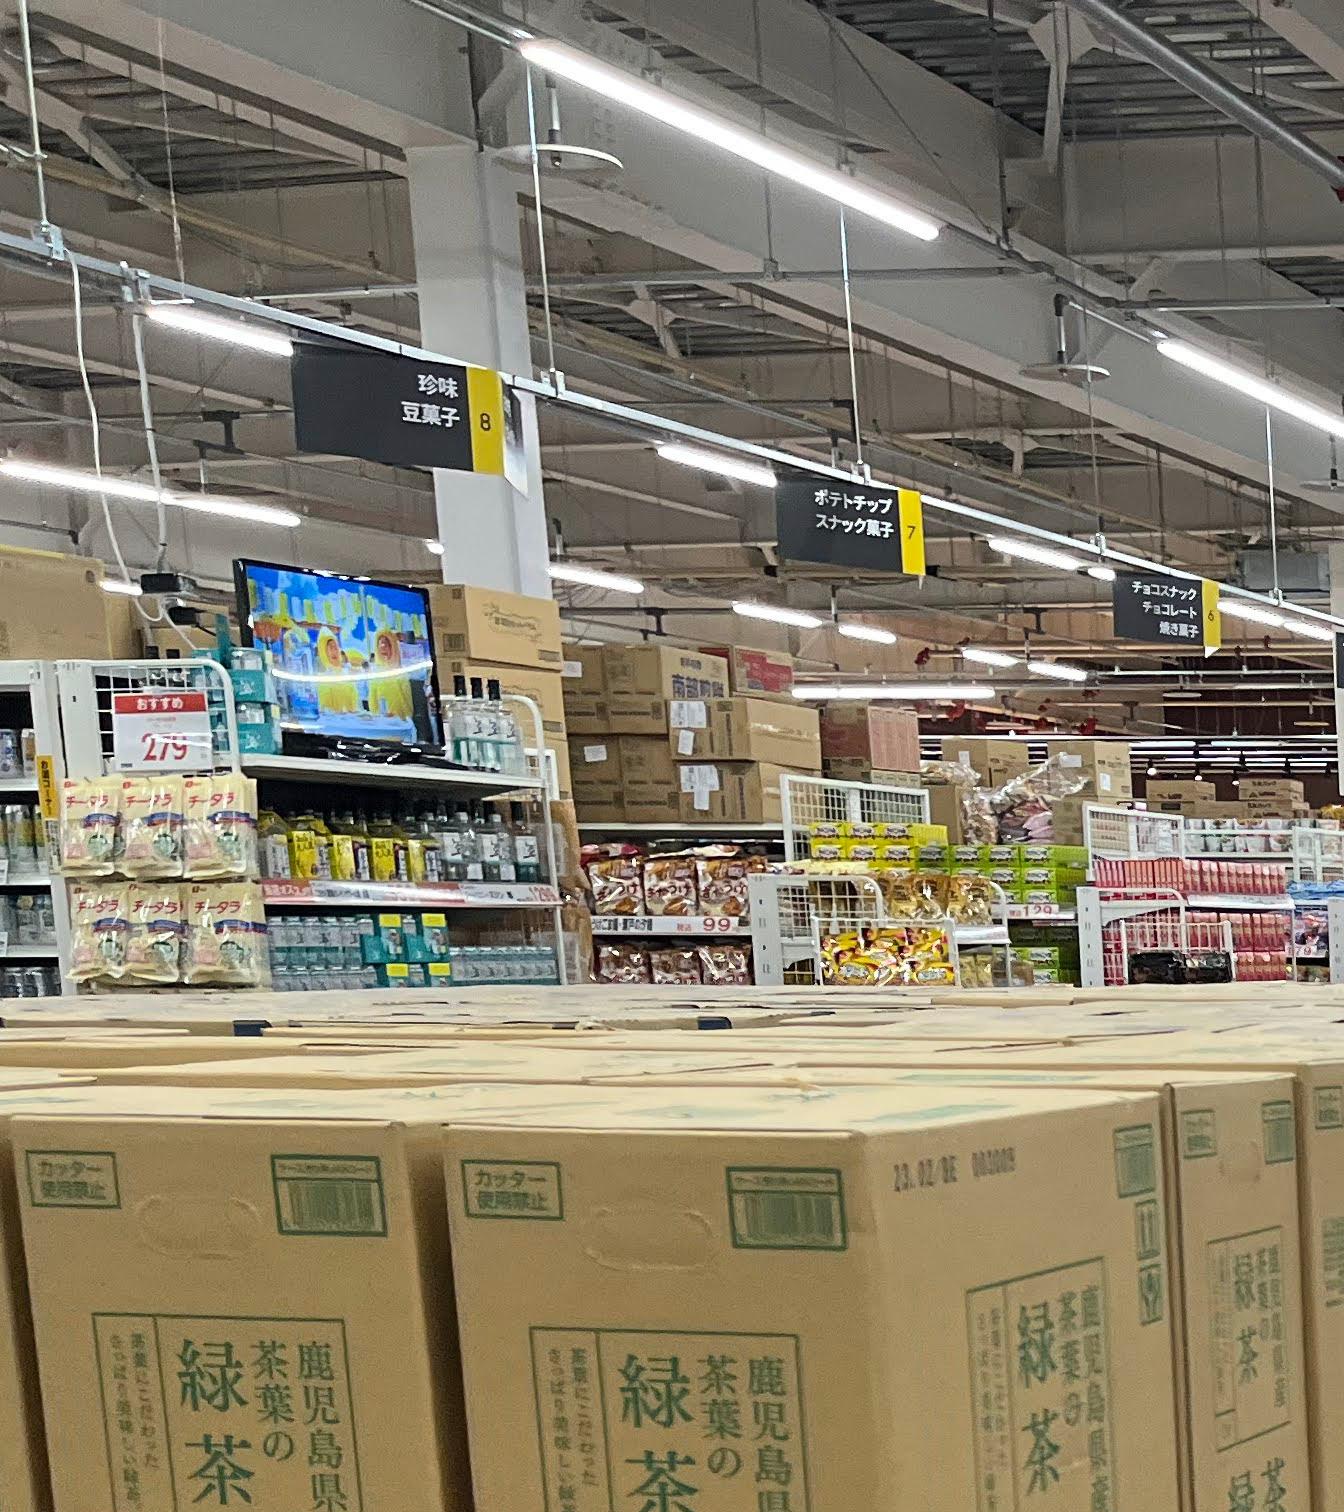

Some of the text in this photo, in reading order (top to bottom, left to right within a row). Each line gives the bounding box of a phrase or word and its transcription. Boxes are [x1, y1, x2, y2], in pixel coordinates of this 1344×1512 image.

[418, 374, 458, 398] 珍味
[401, 401, 460, 427] 豆菓子
[480, 413, 491, 431] 8
[814, 489, 892, 514] ポテトチップ
[816, 514, 894, 538] スナック菓子
[907, 525, 916, 540] 7
[1132, 581, 1197, 600] チョコスナック
[1143, 601, 1197, 619] チョコレート
[136, 698, 184, 711] おすすめ
[703, 918, 731, 931] 99
[38, 1160, 101, 1179] カッター
[474, 1170, 547, 1189] カッター
[250, 1340, 296, 1462] 茶葉の
[1017, 1301, 1060, 1497] 緑茶
[176, 1339, 255, 1507] 緑茶
[696, 1355, 744, 1478] 茶葉の
